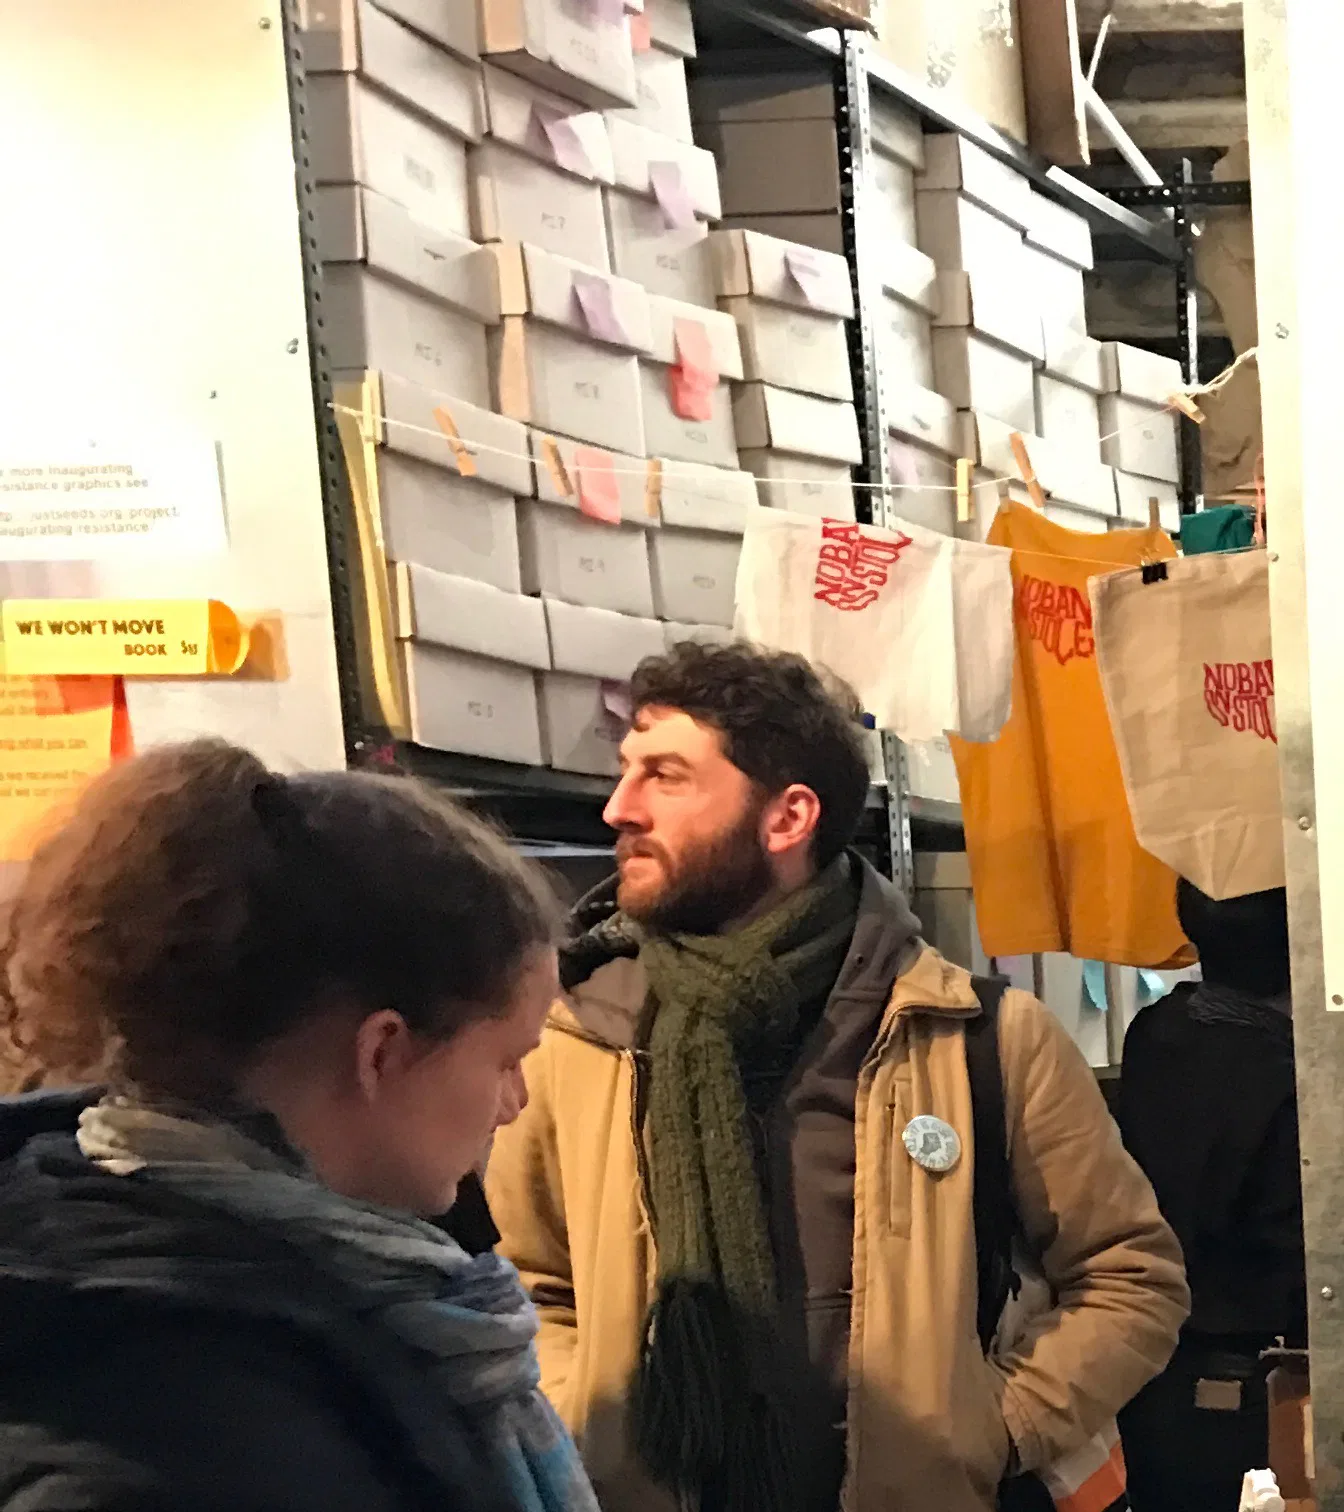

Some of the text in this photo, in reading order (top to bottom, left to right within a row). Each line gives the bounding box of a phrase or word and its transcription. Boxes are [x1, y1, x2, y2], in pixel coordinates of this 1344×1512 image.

[9, 467, 44, 477] more
[63, 477, 122, 492] graphics
[126, 478, 149, 489] see
[16, 619, 165, 636] WE WON'T MOVE
[123, 643, 168, 656] BOOK
